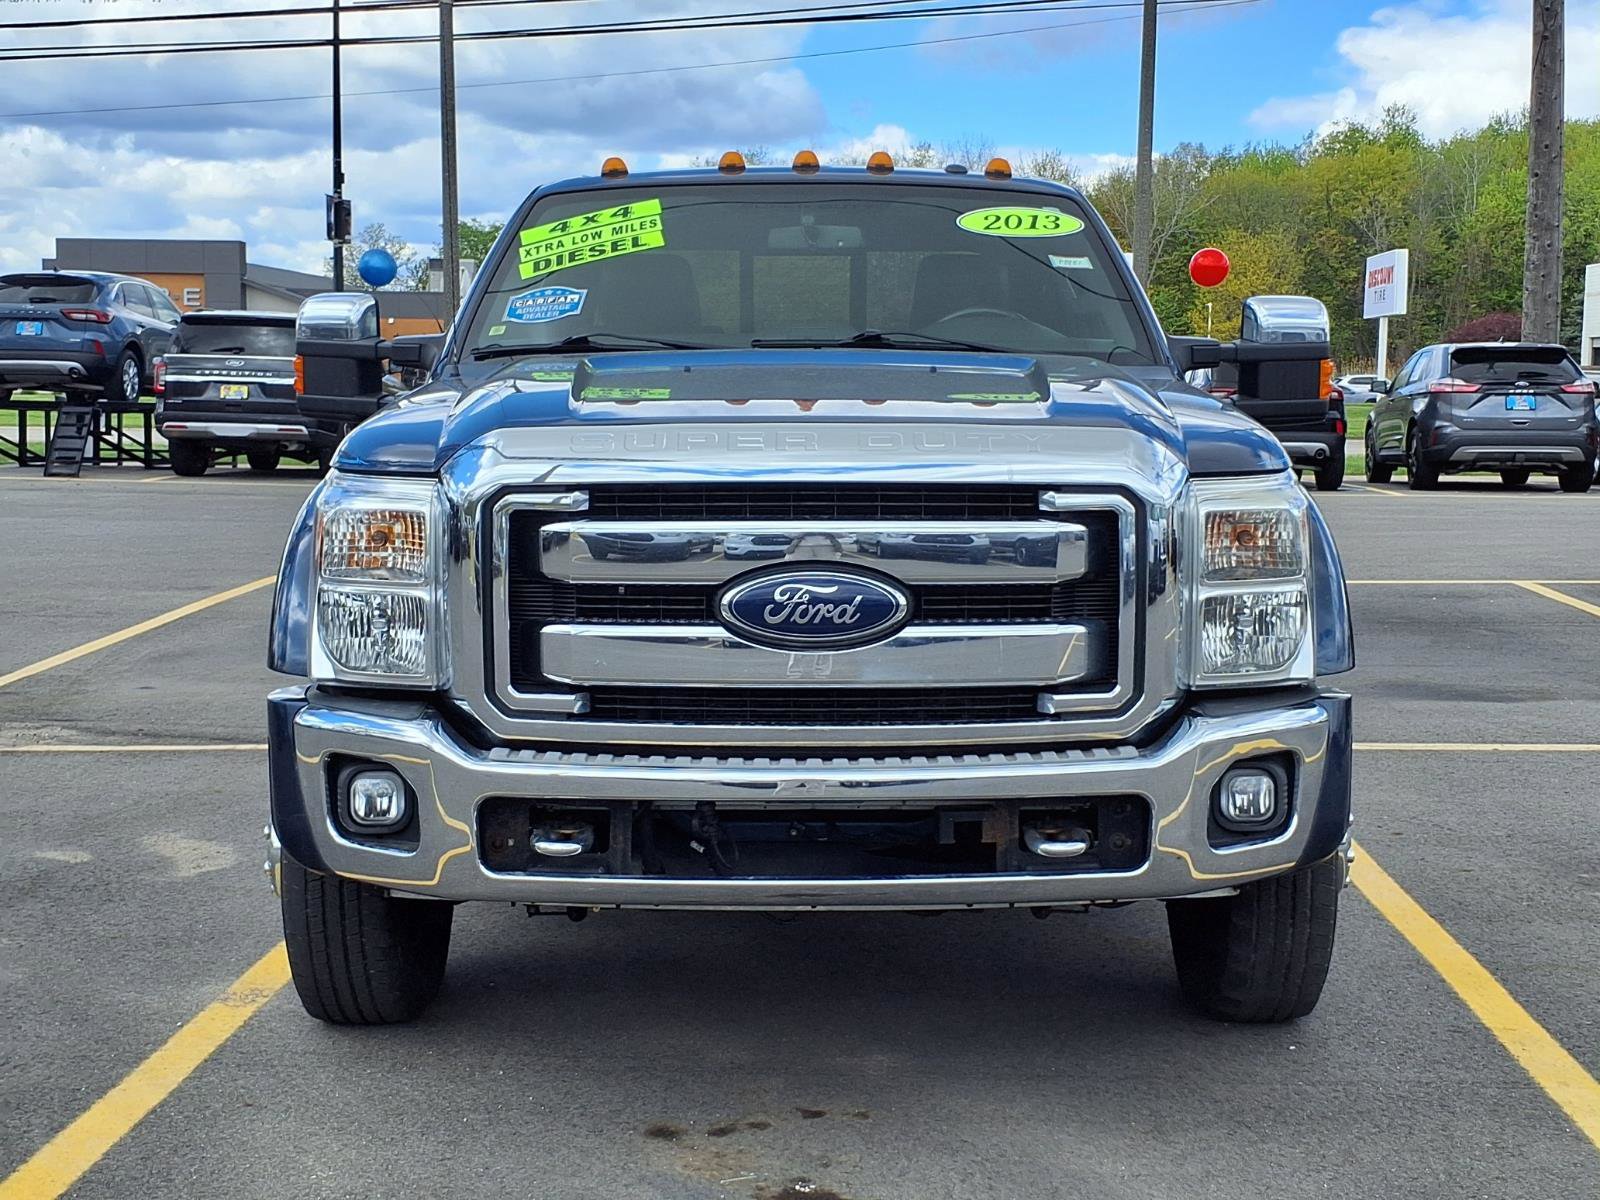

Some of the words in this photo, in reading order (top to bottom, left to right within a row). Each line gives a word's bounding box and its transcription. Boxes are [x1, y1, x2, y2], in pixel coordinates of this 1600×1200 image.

[983, 214, 1061, 231] 2013
[524, 239, 565, 258] XTRA
[572, 230, 602, 246] LOW
[611, 219, 658, 236] MILES
[533, 236, 648, 274] DIESEL
[516, 304, 572, 315] ADVANTAGE
[522, 311, 560, 320] DEALER
[569, 431, 819, 453] SUPER
[859, 431, 1052, 454] DUTY
[763, 583, 863, 625] Ford
